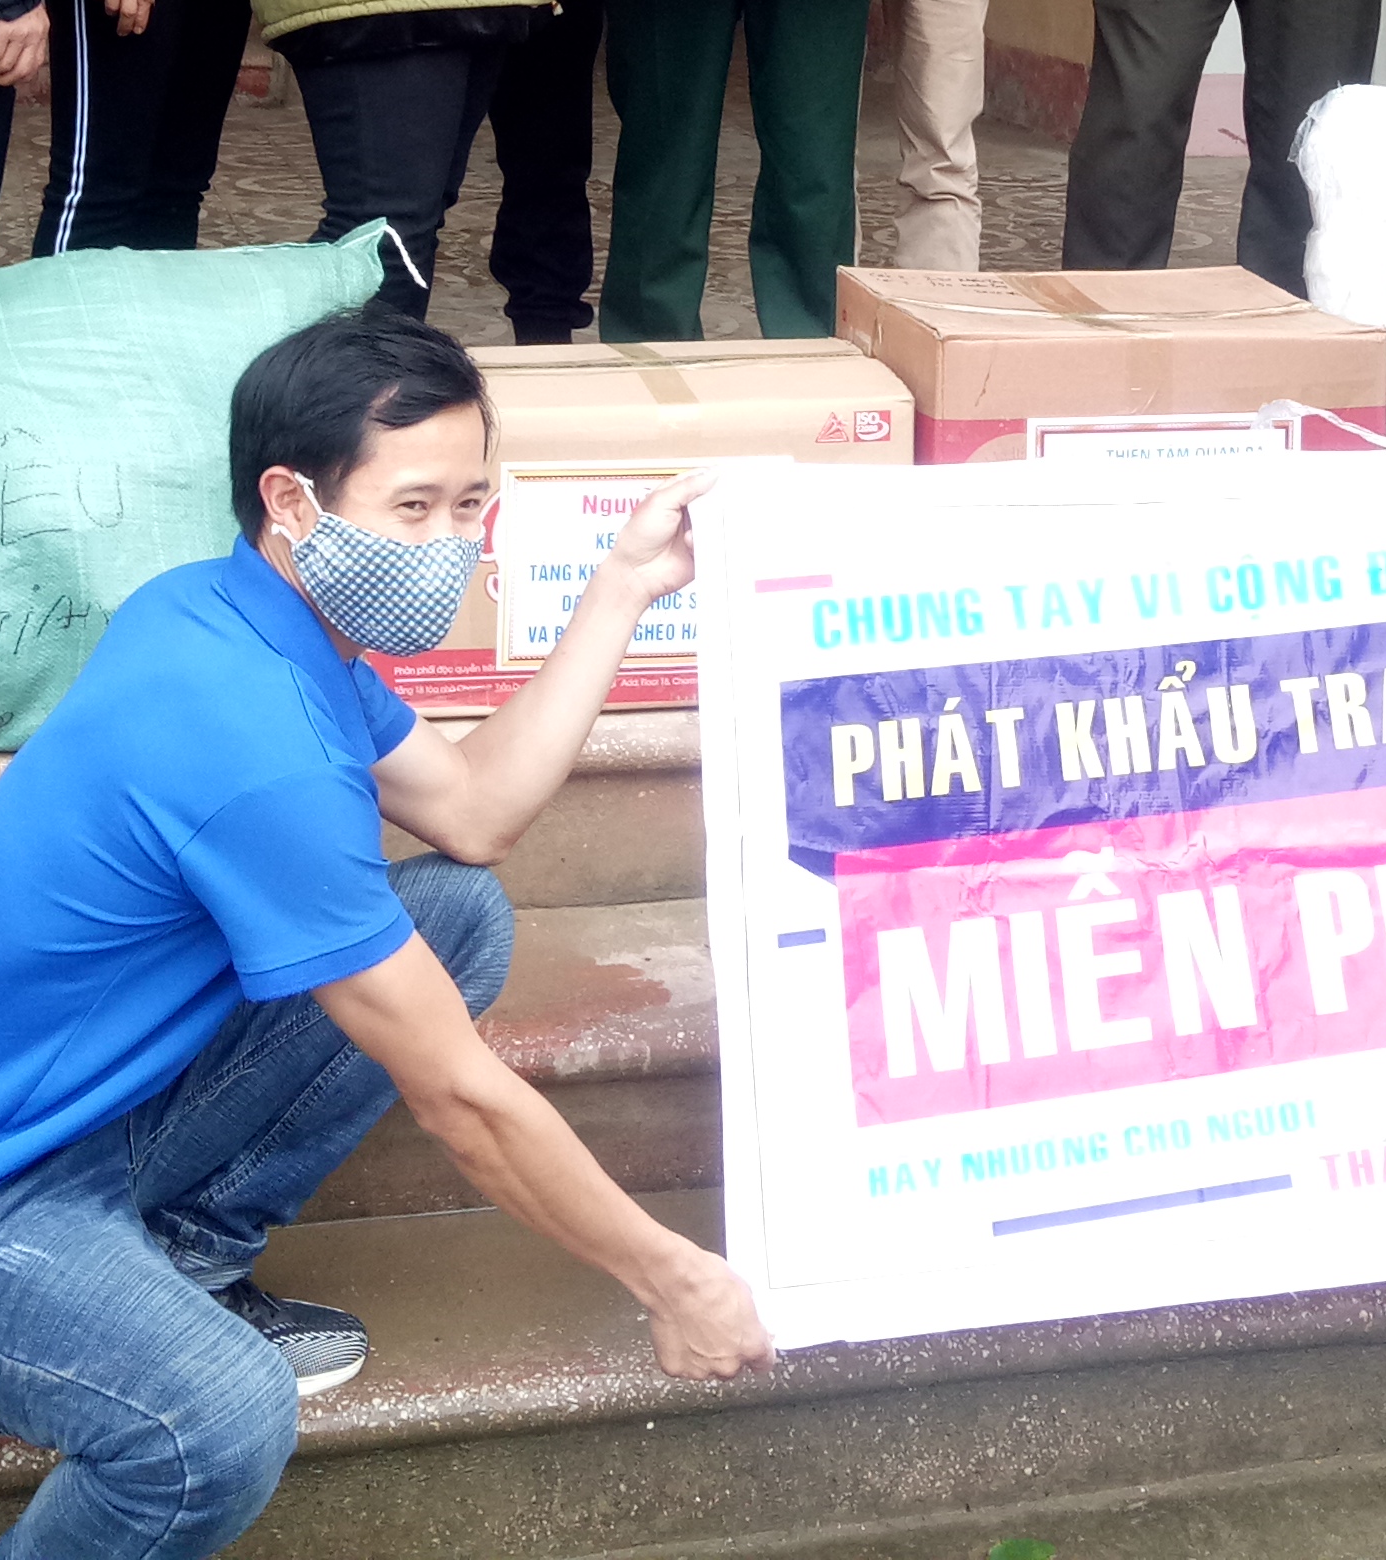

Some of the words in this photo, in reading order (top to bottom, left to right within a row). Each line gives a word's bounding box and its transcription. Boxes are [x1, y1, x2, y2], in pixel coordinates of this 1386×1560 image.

[856, 412, 879, 425] ISO
[582, 494, 635, 517] Nguy
[596, 533, 618, 549] KE
[578, 563, 601, 581] KH
[812, 587, 985, 650] CHUNG
[1003, 577, 1104, 630] TAY
[1205, 554, 1343, 620] CỘNG
[829, 697, 1024, 808] PHÁT
[1056, 659, 1261, 786] KHẨU
[875, 846, 1258, 1080] MIỄN
[1123, 1118, 1192, 1158] CHO
